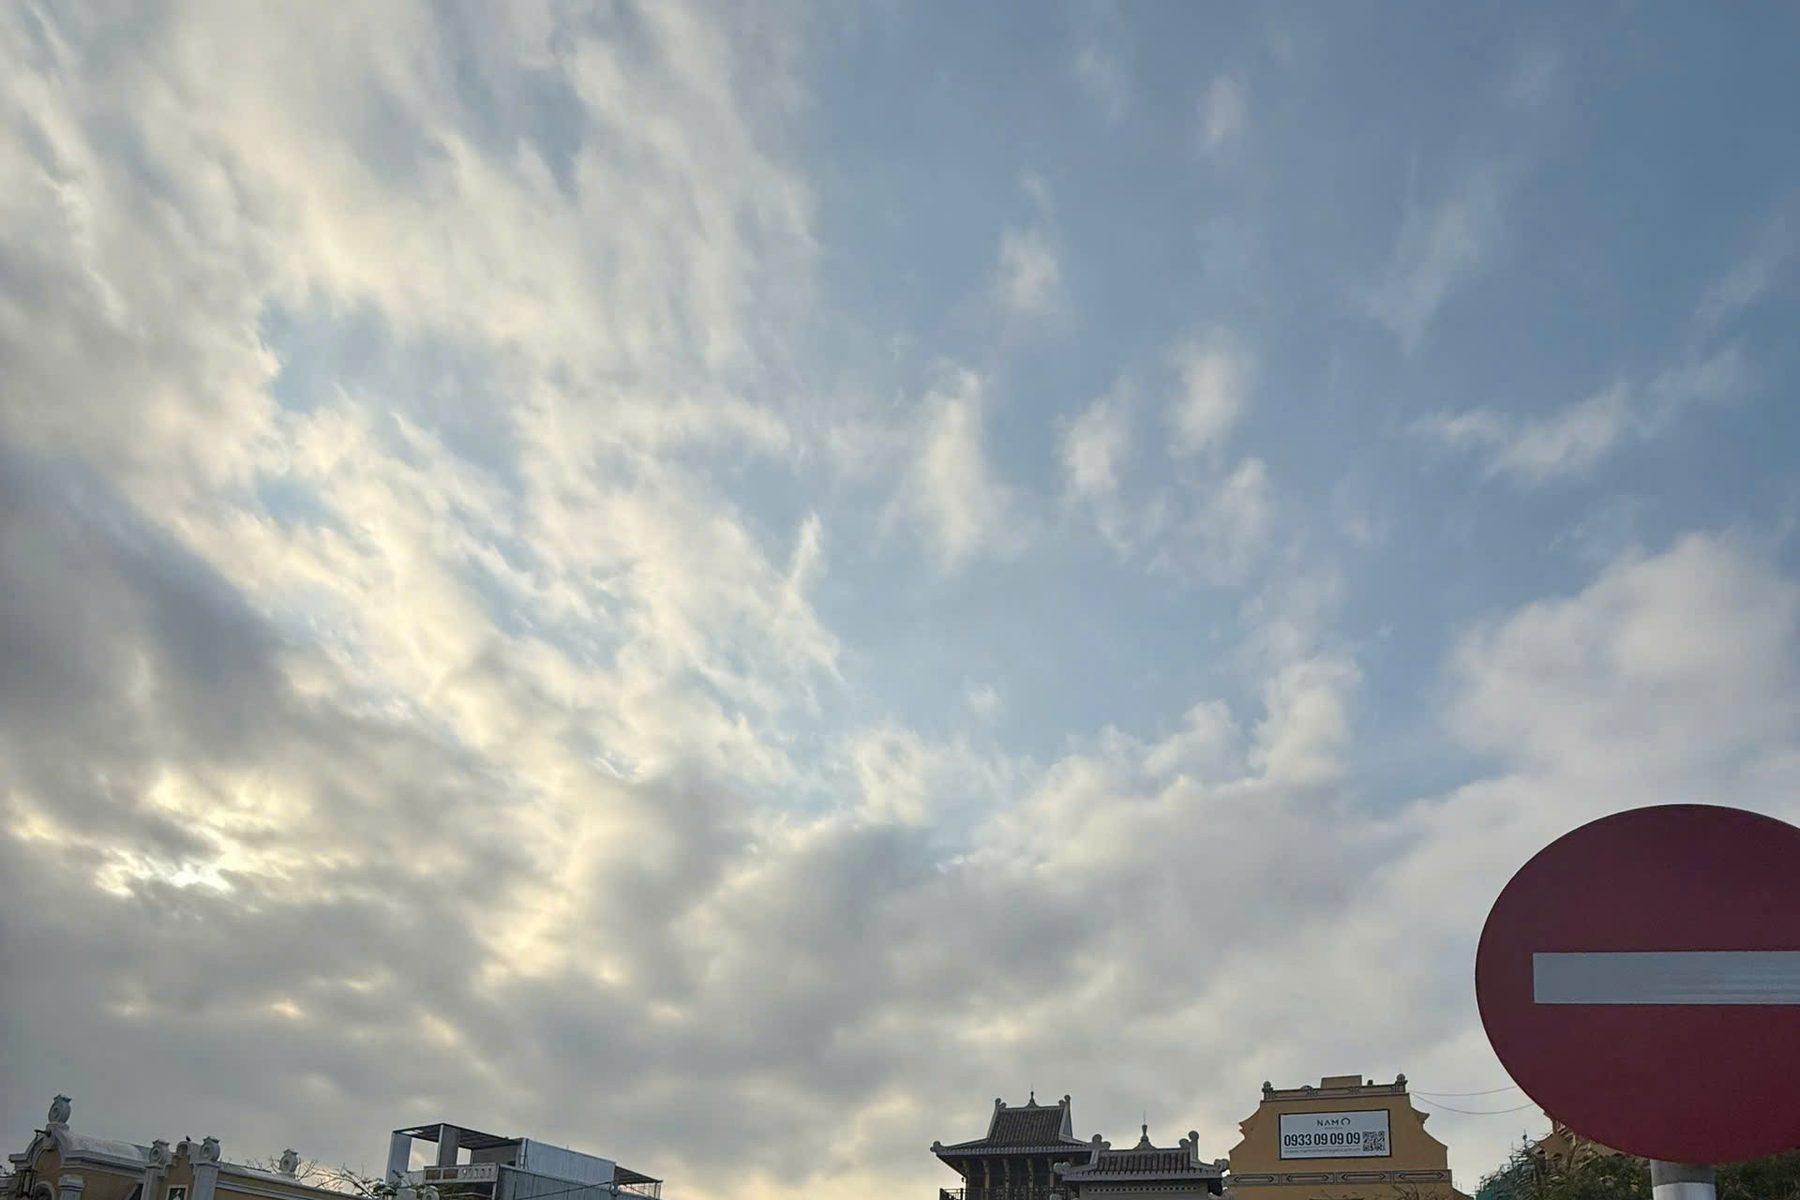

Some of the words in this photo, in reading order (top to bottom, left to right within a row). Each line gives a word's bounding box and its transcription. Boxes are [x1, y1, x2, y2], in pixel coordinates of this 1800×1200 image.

[1284, 1133, 1312, 1147] 0933
[1314, 1133, 1328, 1146] 09
[1330, 1132, 1344, 1145] 09
[1346, 1132, 1361, 1145] 09
